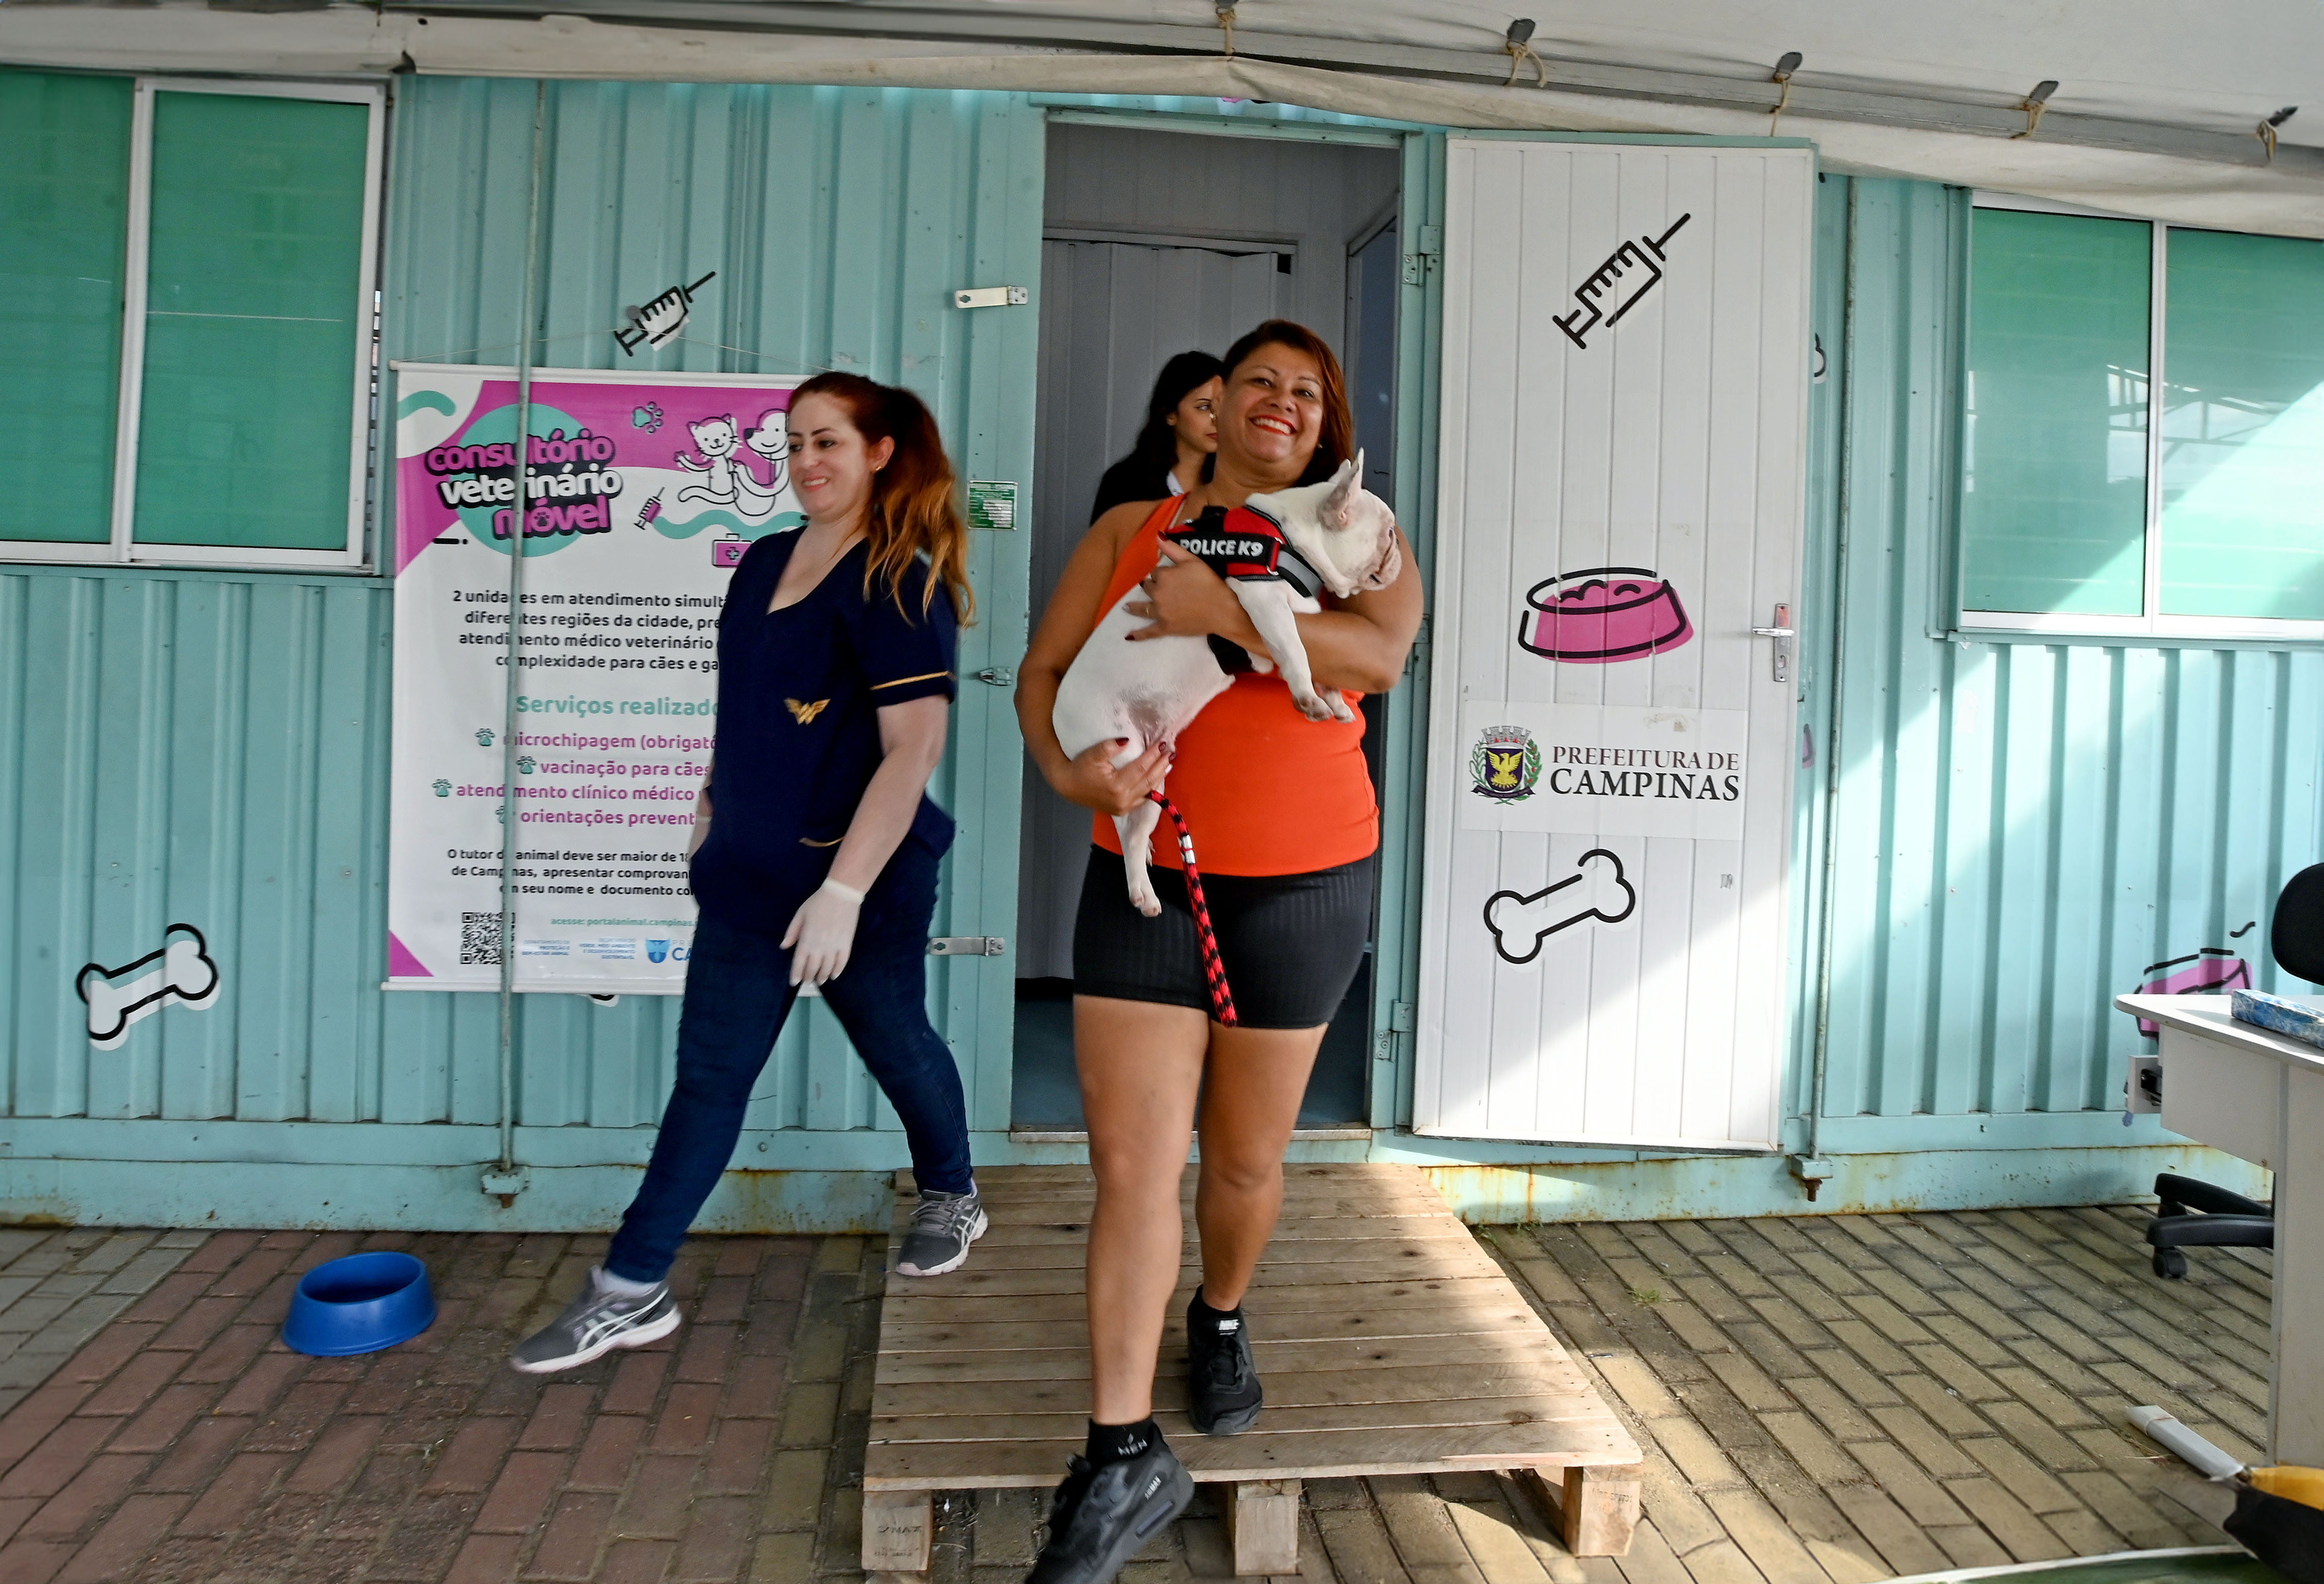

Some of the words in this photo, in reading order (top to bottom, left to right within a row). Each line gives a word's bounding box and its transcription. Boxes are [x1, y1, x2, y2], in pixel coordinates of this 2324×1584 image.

[439, 462, 622, 505] veteinário
[493, 495, 609, 535] móvel
[1180, 539, 1237, 556] POLICE
[1237, 540, 1264, 557] K9
[453, 590, 461, 602] 2
[465, 590, 538, 604] unidaes
[541, 594, 565, 604] em
[569, 593, 671, 607] atendimento
[675, 594, 726, 607] simult
[551, 613, 610, 629] regiões
[614, 614, 632, 627] da
[637, 614, 693, 630] cidade,
[564, 633, 622, 648] médico
[625, 635, 714, 650] veterinário
[610, 658, 645, 672] para
[649, 656, 685, 670] cães
[689, 660, 697, 670] e
[701, 660, 719, 674] ga
[516, 694, 614, 718] Serviços
[1552, 745, 1703, 770] PREFEITURA
[1707, 751, 1739, 771] DE
[540, 759, 627, 778] vacinação
[631, 764, 669, 778] para
[456, 783, 567, 799] atendmento
[572, 784, 628, 800] clínico
[632, 785, 695, 801] médico
[1550, 768, 1740, 802] CAMPINAS
[521, 808, 624, 827] orientações
[628, 812, 695, 827] prevent
[447, 848, 457, 859] O
[460, 849, 494, 859] tutor
[496, 849, 505, 860] d
[515, 849, 560, 860] animal
[562, 850, 594, 861] deve
[596, 852, 618, 861] ser
[620, 851, 658, 862] maior
[661, 851, 677, 862] de
[451, 866, 468, 876] de
[470, 866, 537, 879] Campnas,
[543, 868, 615, 879] apresentar
[617, 870, 690, 880] comprovan
[522, 885, 545, 894] seu
[547, 886, 584, 894] nome
[587, 886, 594, 895] e
[600, 885, 674, 895] documento
